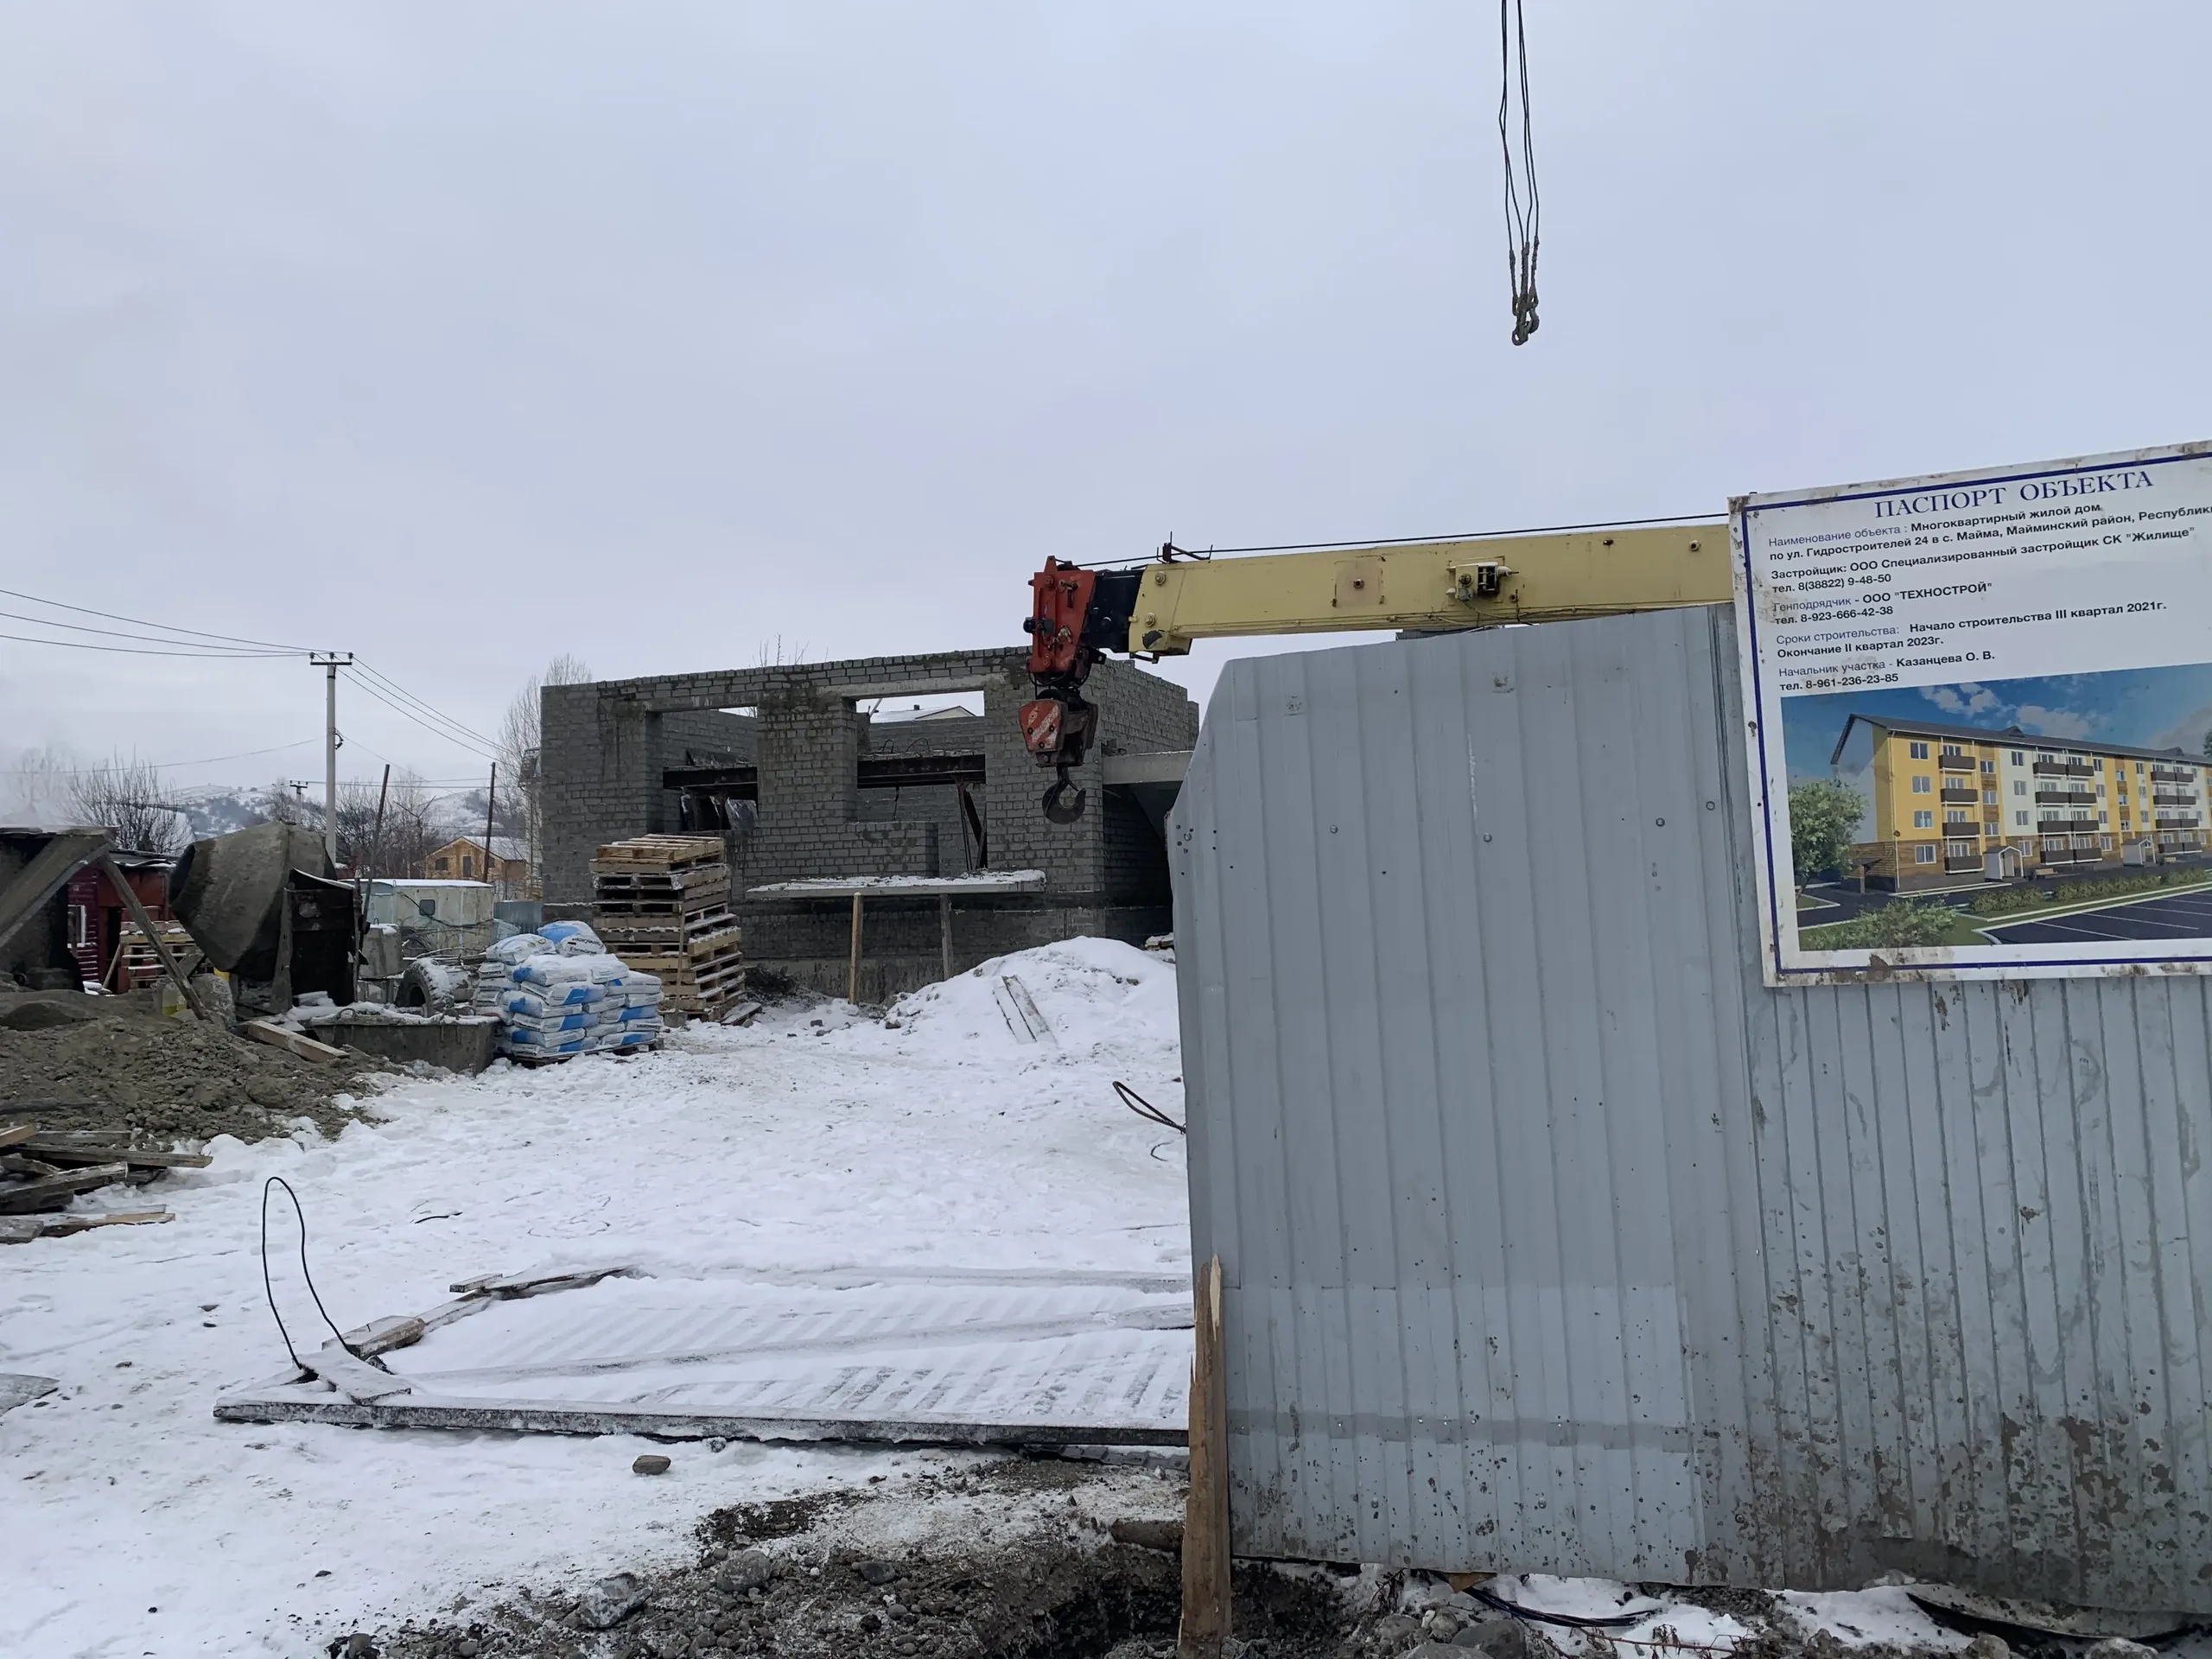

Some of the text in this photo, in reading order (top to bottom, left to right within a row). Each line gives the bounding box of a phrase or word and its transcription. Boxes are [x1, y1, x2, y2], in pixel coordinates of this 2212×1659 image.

[1875, 471, 2154, 518] ПАСПОРТ ОБЪЕКТА
[1769, 531, 1852, 547] Наименование
[1854, 525, 1901, 538] объекта
[1910, 511, 2026, 532] Многоквартирный
[2030, 506, 2070, 519] жилой
[1770, 552, 1784, 561] по
[1788, 550, 1803, 561] ул.
[1807, 538, 1911, 557] Гидростроителей
[1915, 537, 1929, 545] 24
[1943, 534, 1953, 543] с.
[1957, 528, 2003, 541] Майма,
[2006, 519, 2088, 536] Майминский
[2092, 513, 2135, 528] район,
[2139, 505, 2212, 521] Республик
[1771, 527, 2195, 579] Застройщик: ООО Специализированный застройщик СК "Жилище"
[1772, 574, 1891, 593] тел. 8(38822) 9-48-50
[1772, 598, 1852, 613] Генподрядчик
[1863, 592, 1891, 604] ООО
[1895, 582, 1992, 600] "ТЕХНОСТРОЙ"
[1775, 607, 1893, 625] тел. 8-923-666-42-38
[1777, 601, 2167, 645] Сроки строительства: Начало строительства III квартал 2021г.
[1777, 636, 1943, 658] Окончание II квартал 2023г.
[1779, 664, 1839, 677] Начальник
[1842, 661, 1885, 673] участка
[1897, 654, 1962, 667] Казанцева
[1966, 652, 1979, 661] О.
[1983, 651, 1995, 659] В.
[1806, 673, 1898, 688] 8-961-236-23-85
